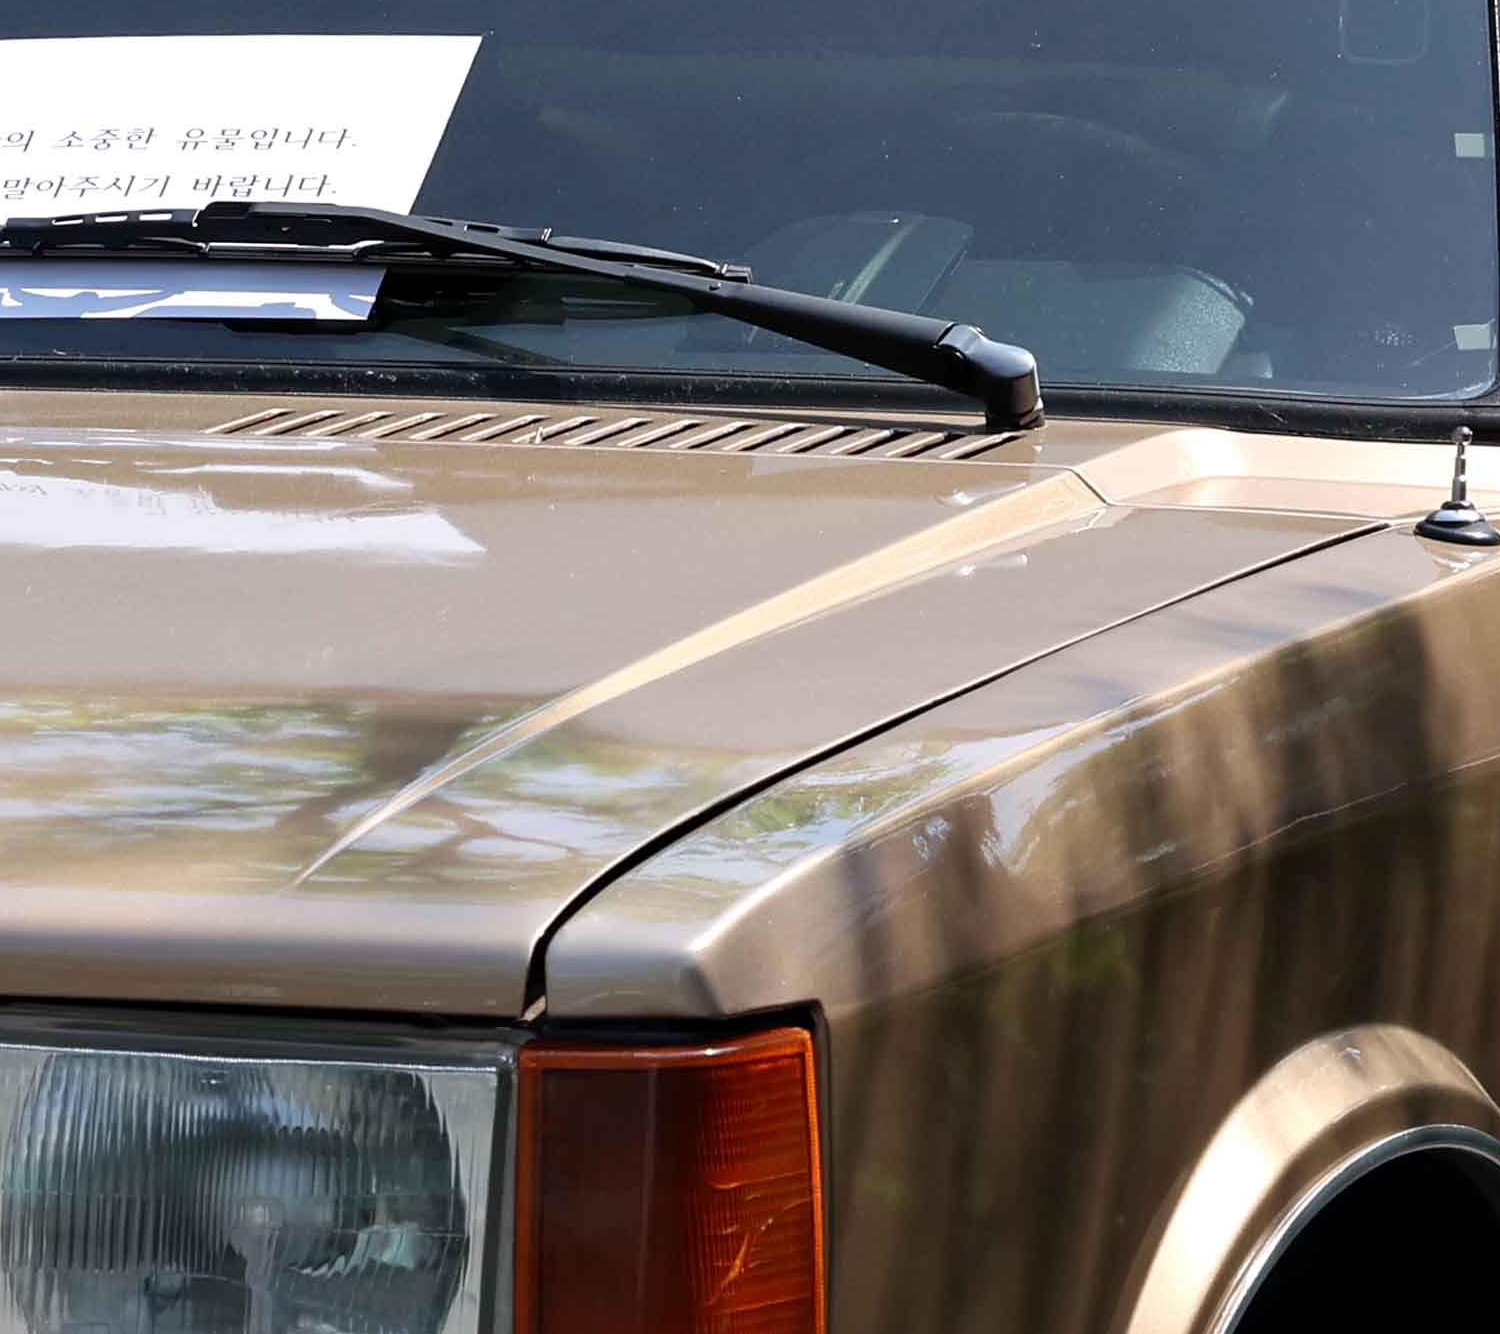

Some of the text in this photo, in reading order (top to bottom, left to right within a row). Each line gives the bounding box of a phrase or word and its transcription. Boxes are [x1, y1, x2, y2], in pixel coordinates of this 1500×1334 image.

[51, 126, 158, 151] 소중한
[175, 127, 358, 152] 유물입니다.
[2, 174, 171, 201] 말아주시기
[192, 173, 338, 199] 바랍니다.
